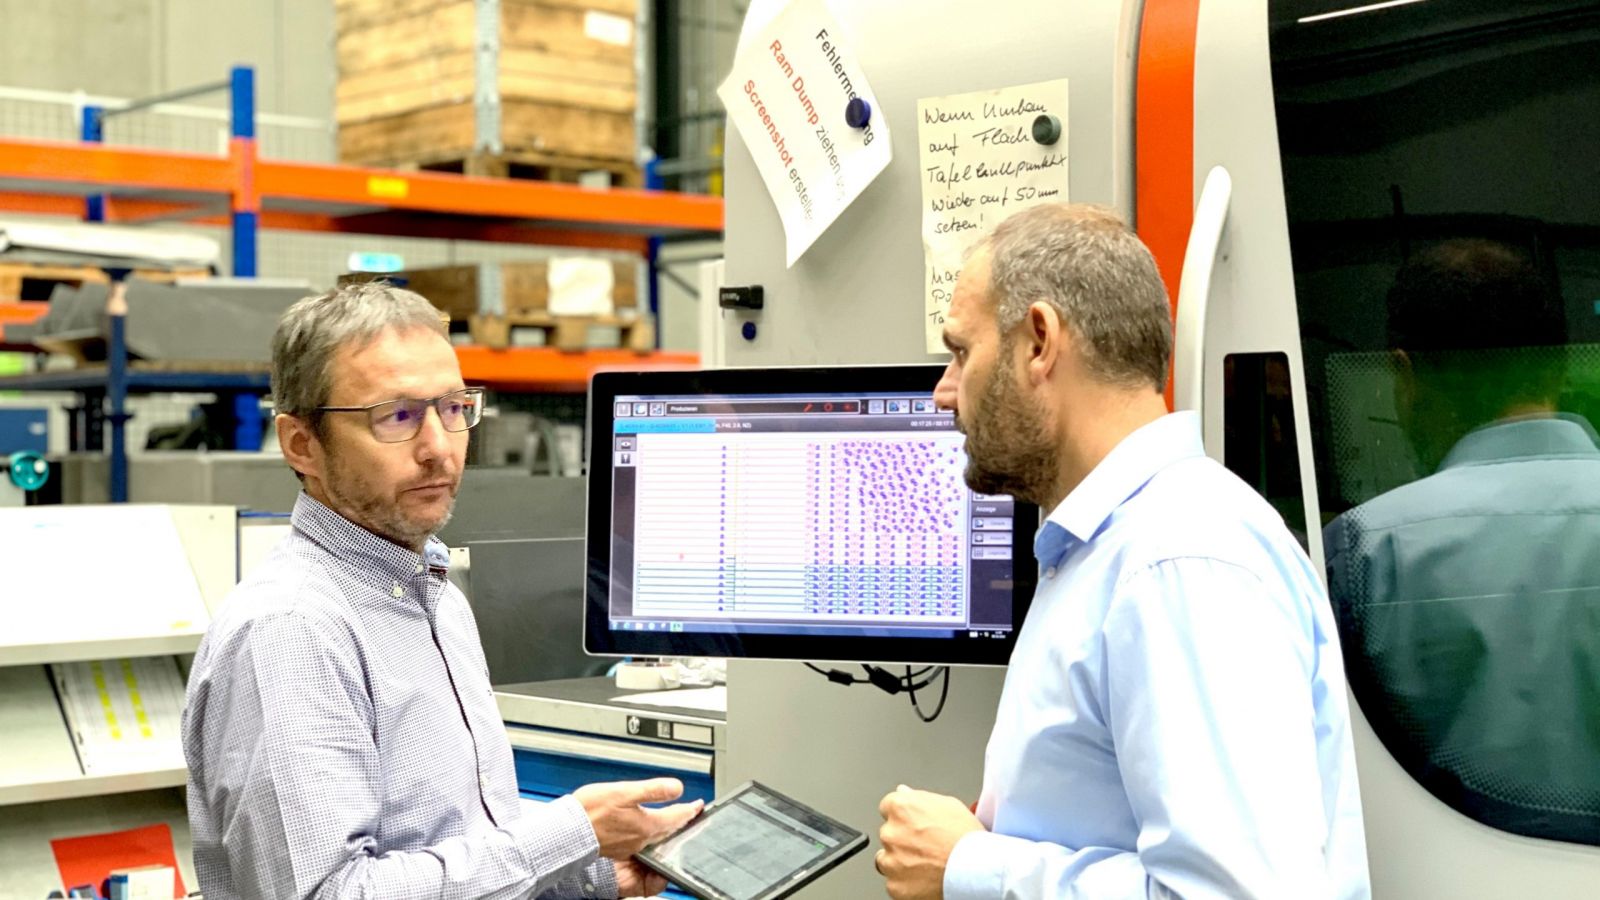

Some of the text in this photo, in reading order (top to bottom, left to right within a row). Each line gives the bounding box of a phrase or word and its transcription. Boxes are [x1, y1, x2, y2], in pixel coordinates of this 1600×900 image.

[815, 28, 875, 147] Fehlermeng
[769, 39, 795, 78] Ram
[792, 76, 820, 126] Dump
[815, 125, 842, 175] ziehen
[924, 107, 975, 125] Wenn
[744, 79, 814, 221] Screenshot erstelle
[929, 133, 960, 157] auf
[980, 187, 1009, 206] auf
[934, 213, 984, 234] setzen!
[930, 266, 961, 286] Mas
[931, 288, 953, 304] Po
[928, 310, 945, 326] Ta
